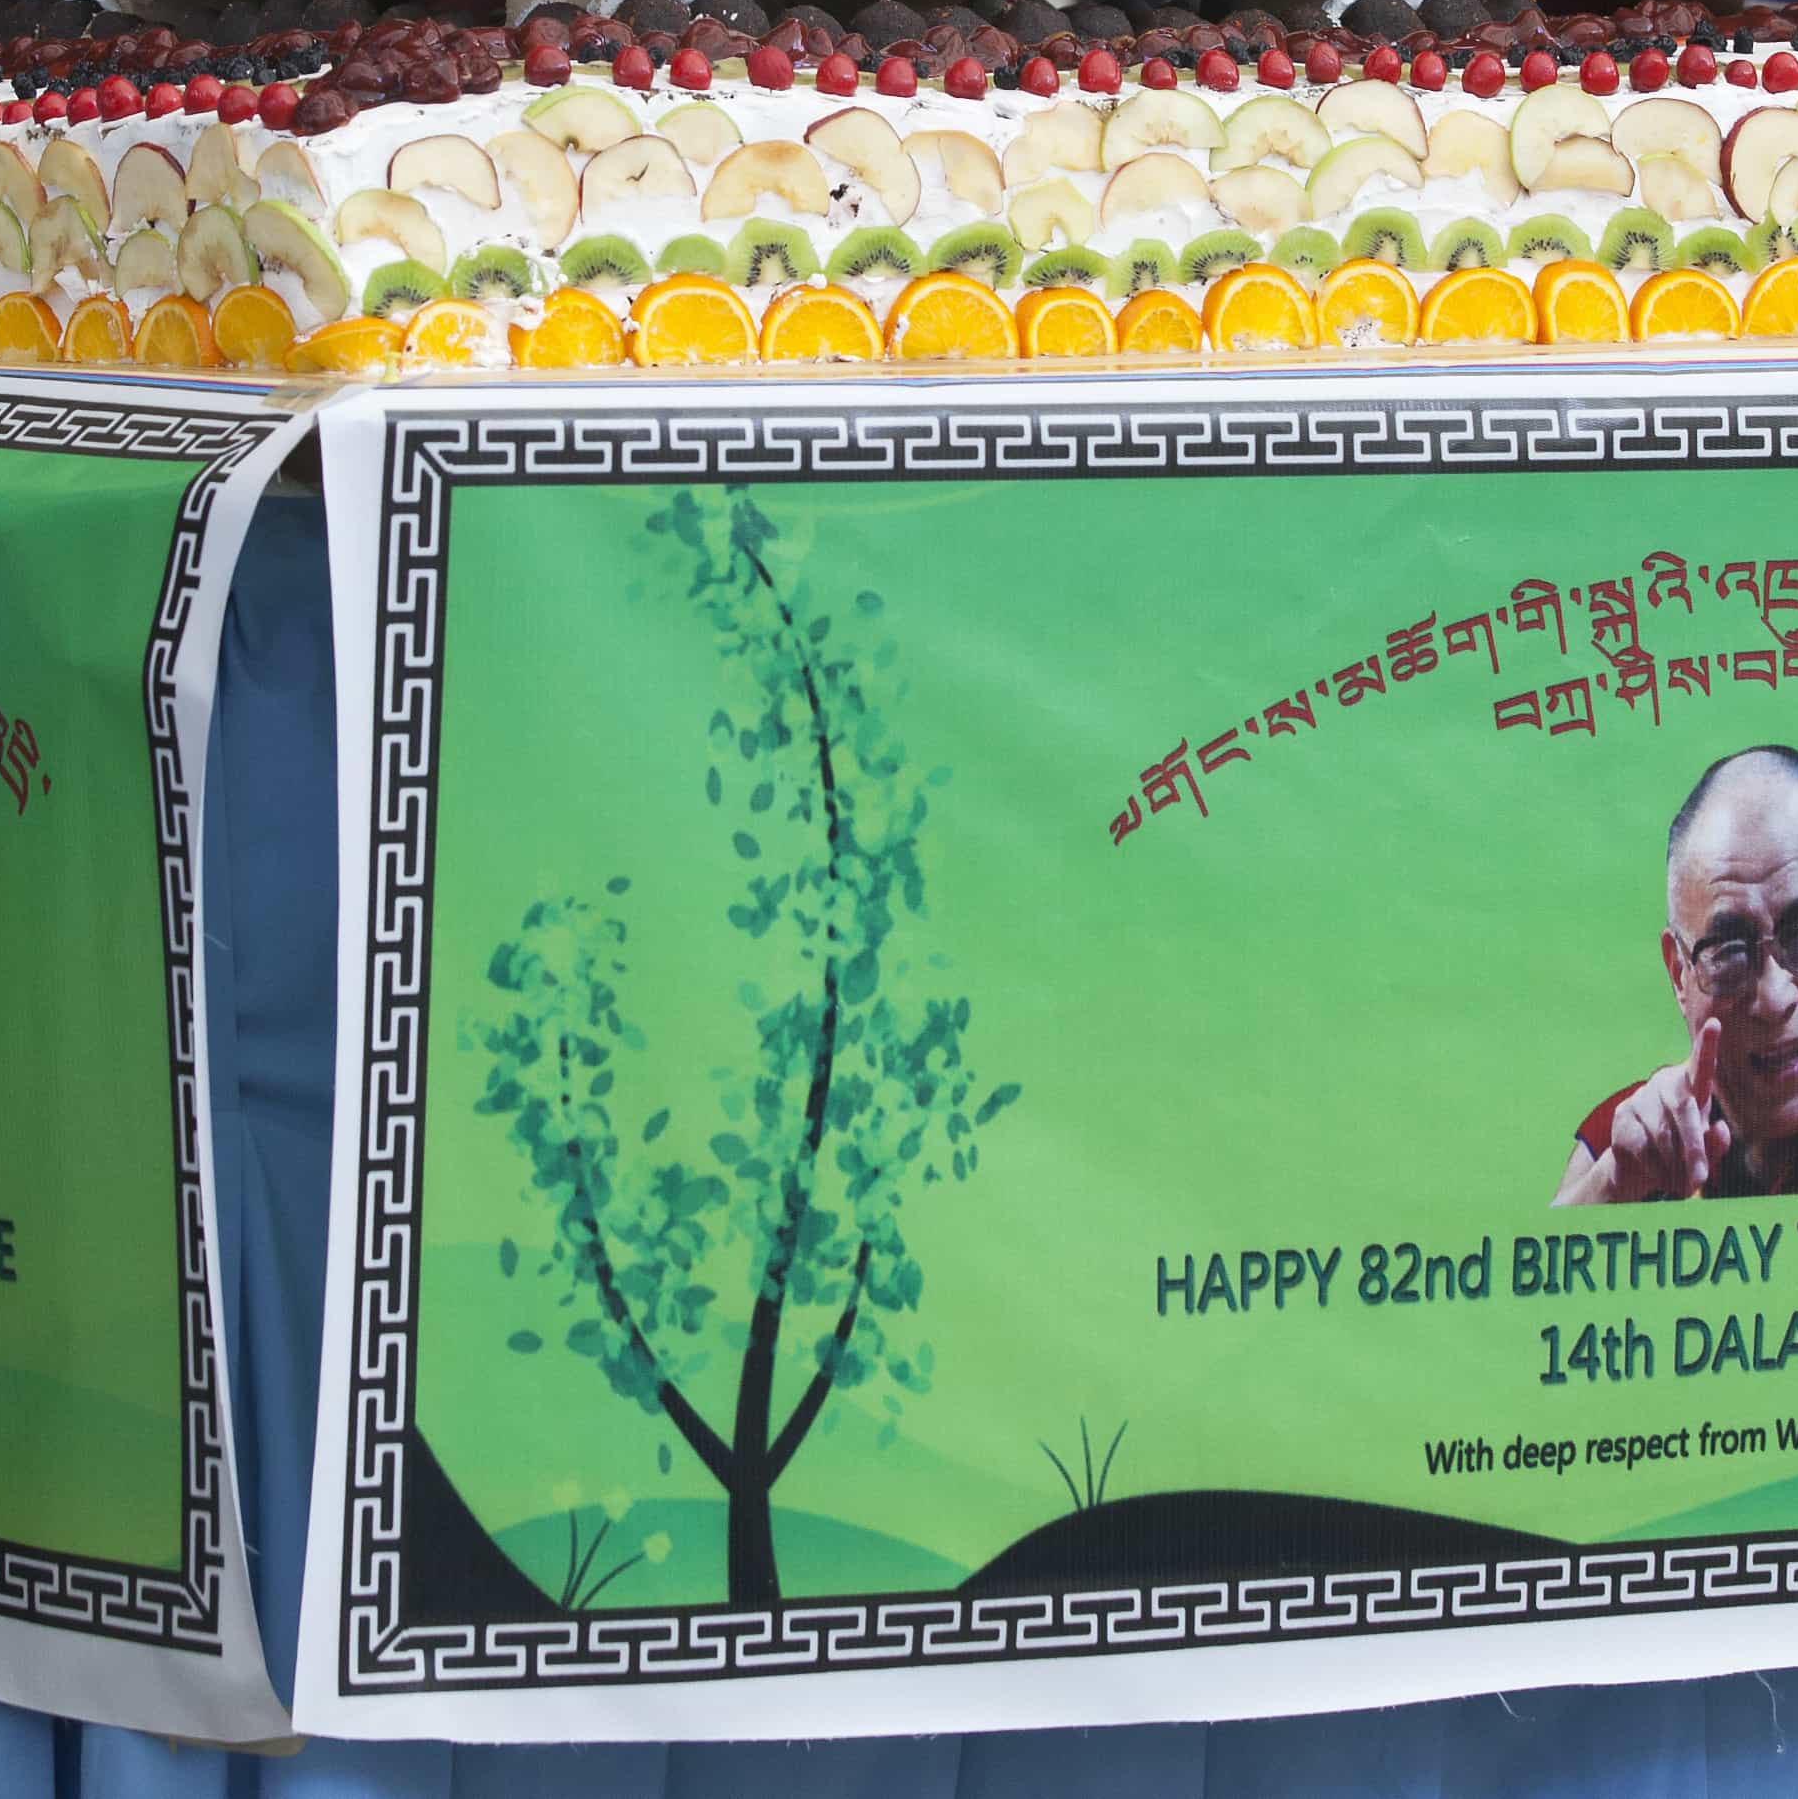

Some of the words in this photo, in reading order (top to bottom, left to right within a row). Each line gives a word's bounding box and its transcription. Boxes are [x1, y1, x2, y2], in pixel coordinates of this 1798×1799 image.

[1156, 1246, 1341, 1316] HAPPY
[1358, 1235, 1492, 1304] 82nd
[1512, 1222, 1783, 1297] BIRTHDAY
[1539, 1317, 1655, 1386] 14th
[1424, 1437, 1494, 1475] With
[1503, 1434, 1576, 1475] deep
[1586, 1428, 1690, 1471] respect
[1699, 1421, 1766, 1458] from
